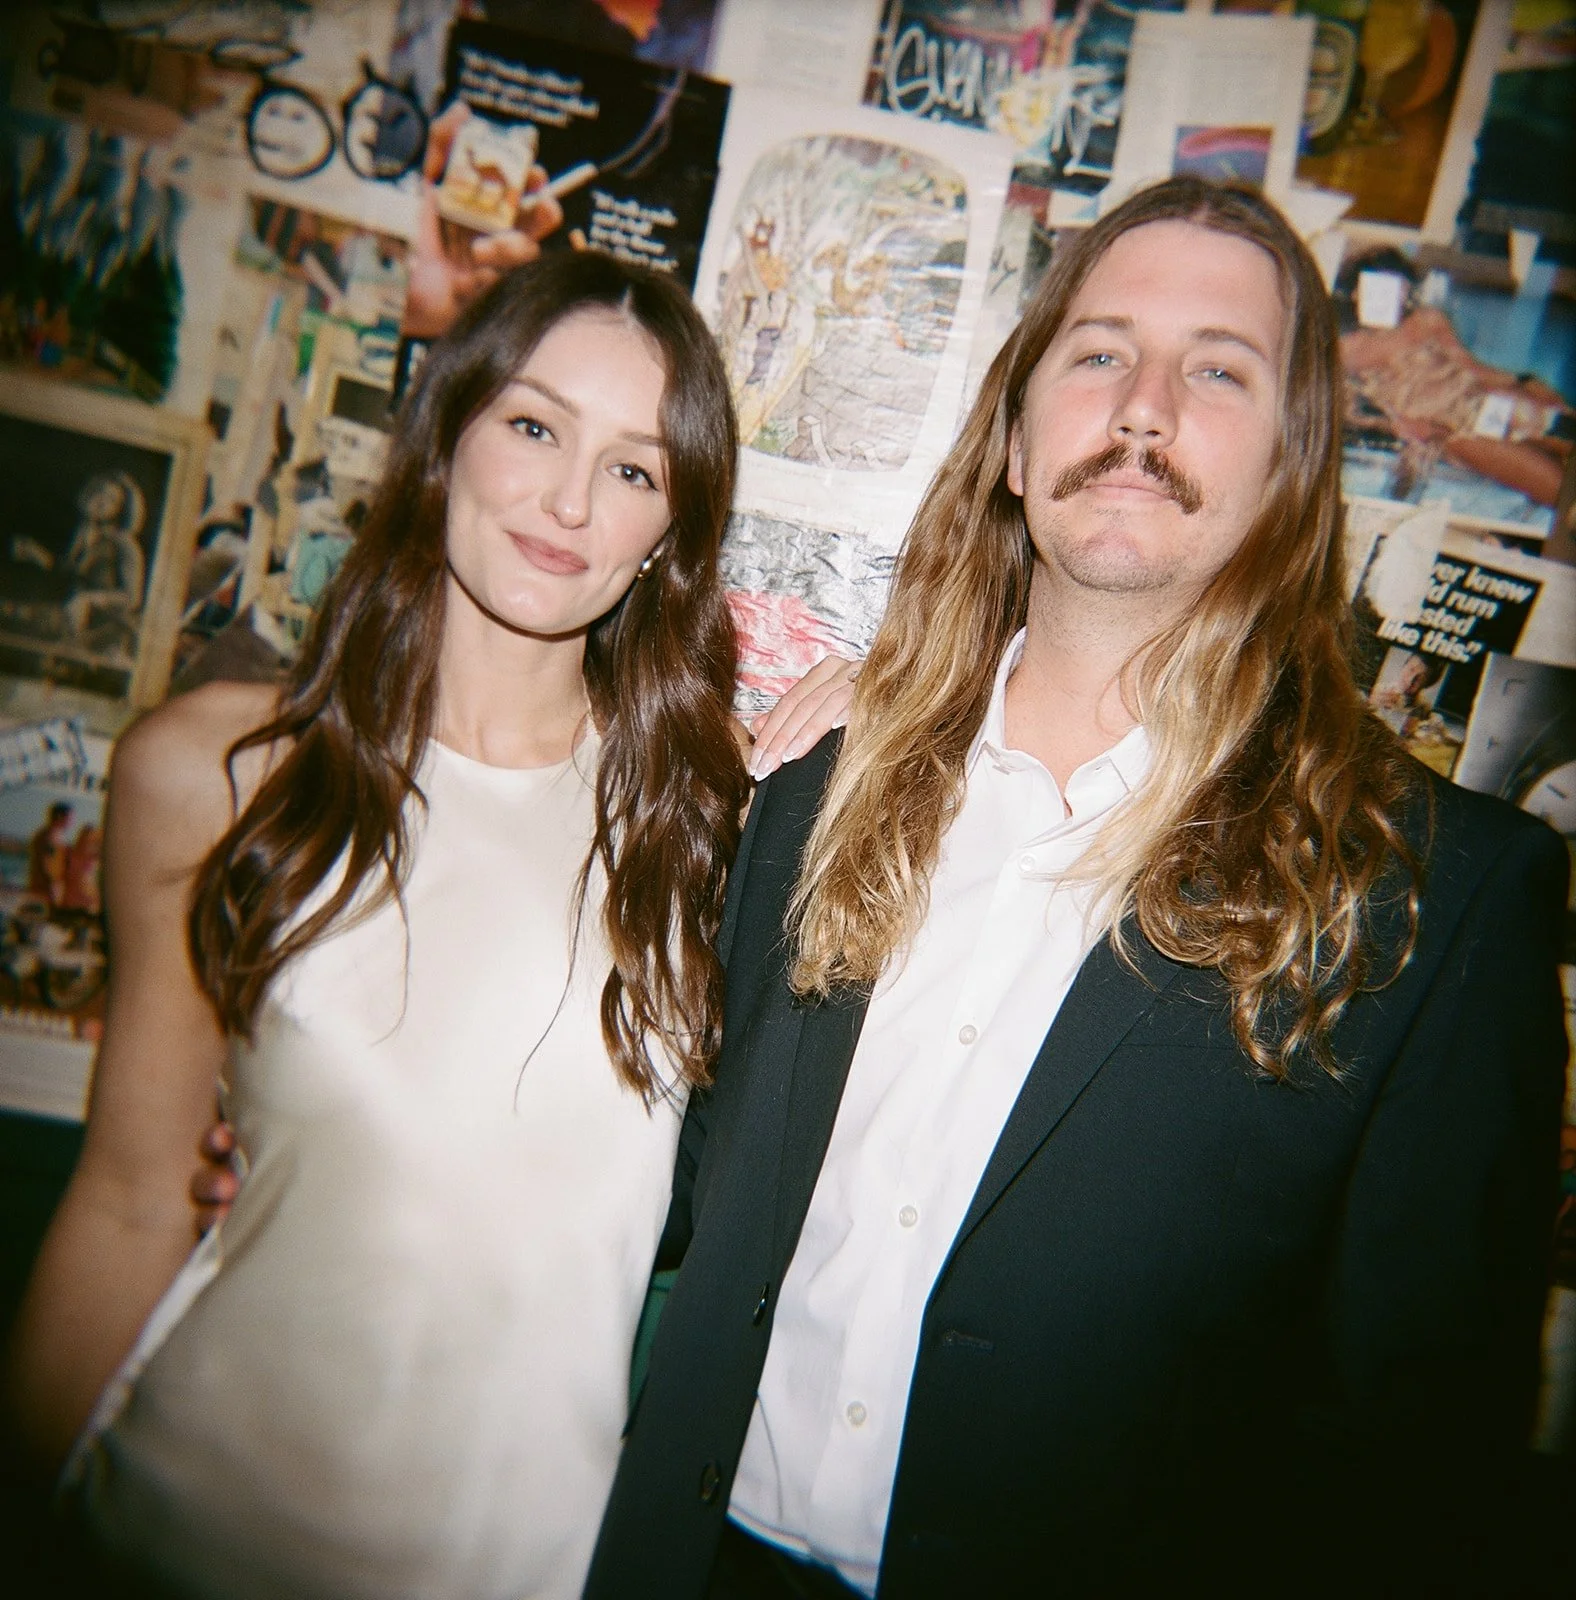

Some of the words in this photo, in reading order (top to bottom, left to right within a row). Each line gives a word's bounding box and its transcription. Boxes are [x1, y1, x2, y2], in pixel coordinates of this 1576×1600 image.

[1463, 566, 1533, 604] knew
[1446, 590, 1499, 620] rum
[1376, 617, 1421, 646] like
[1420, 606, 1477, 637] sted
